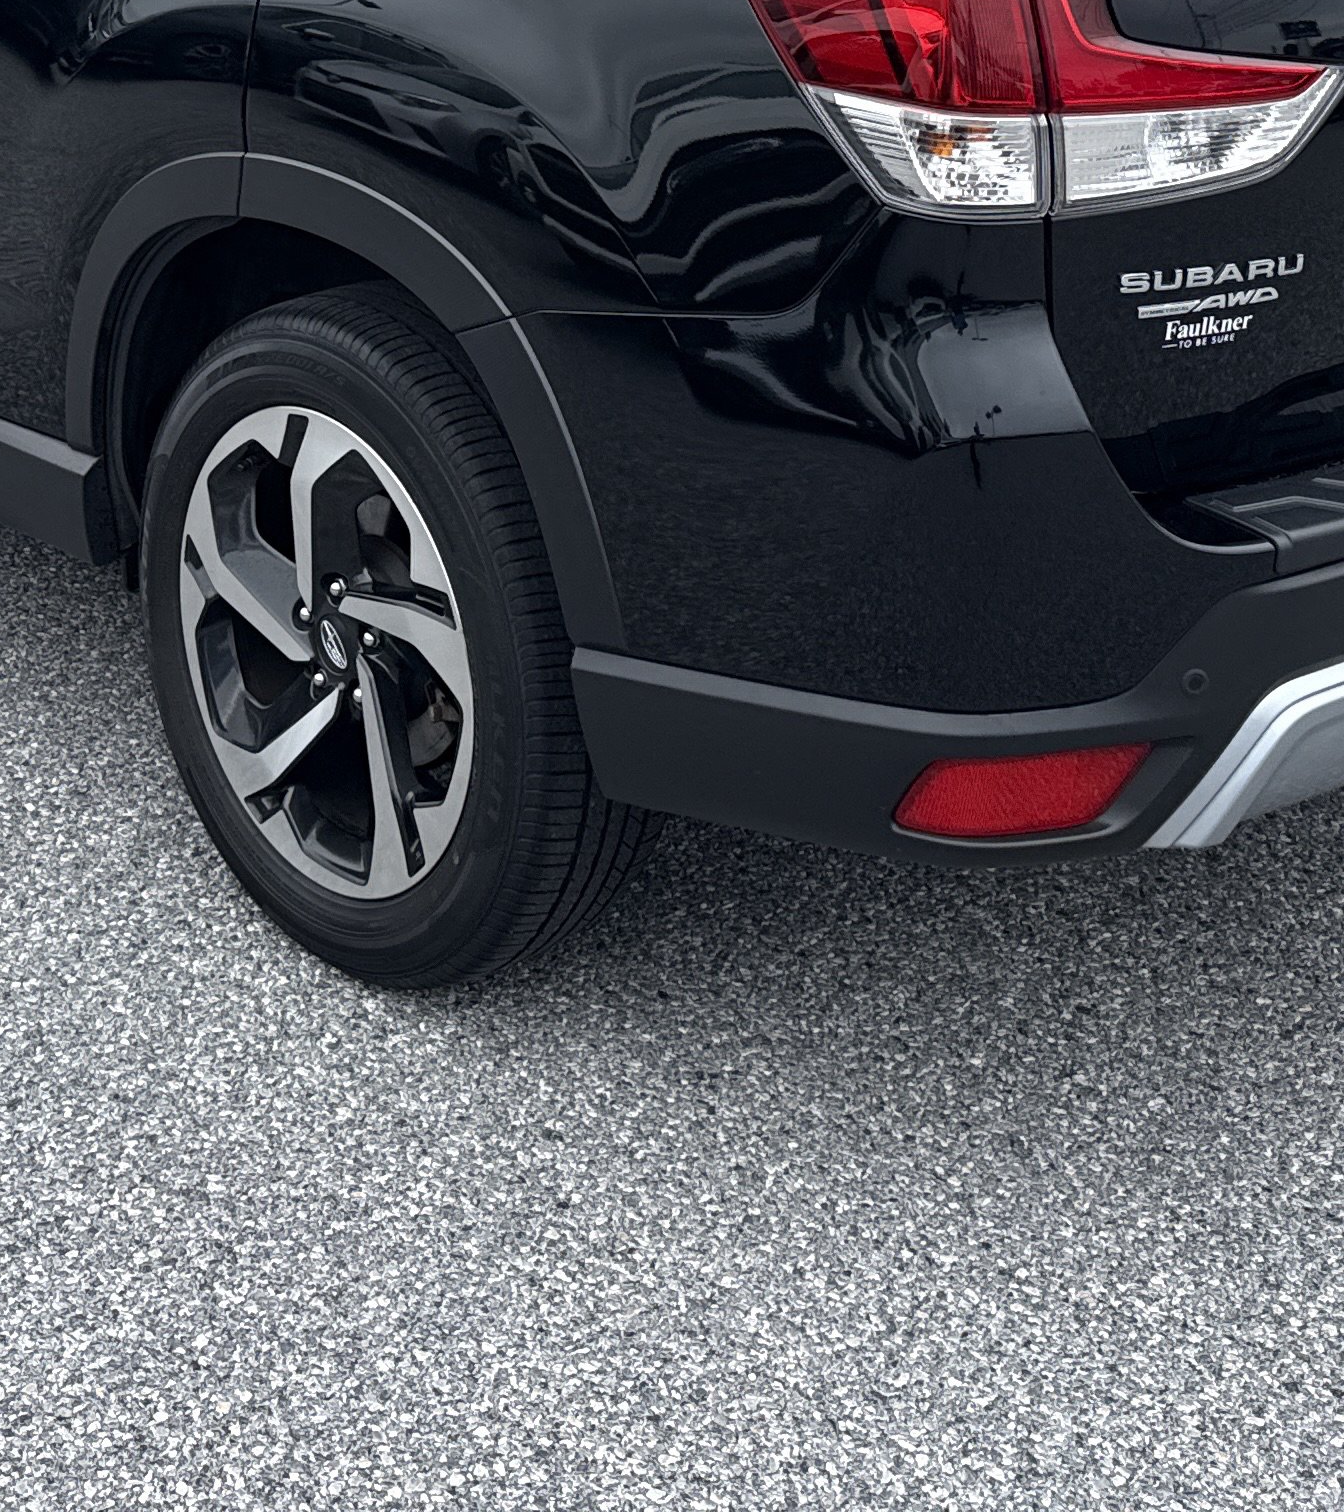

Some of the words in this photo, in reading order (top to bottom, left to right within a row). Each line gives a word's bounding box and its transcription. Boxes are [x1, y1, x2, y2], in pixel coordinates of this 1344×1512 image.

[1119, 253, 1305, 294] SUBARU
[1192, 286, 1279, 312] AWD
[1164, 314, 1254, 341] Faulkner
[1178, 339, 1193, 349] TO
[1195, 337, 1207, 346] BE
[1211, 333, 1236, 345] SURE
